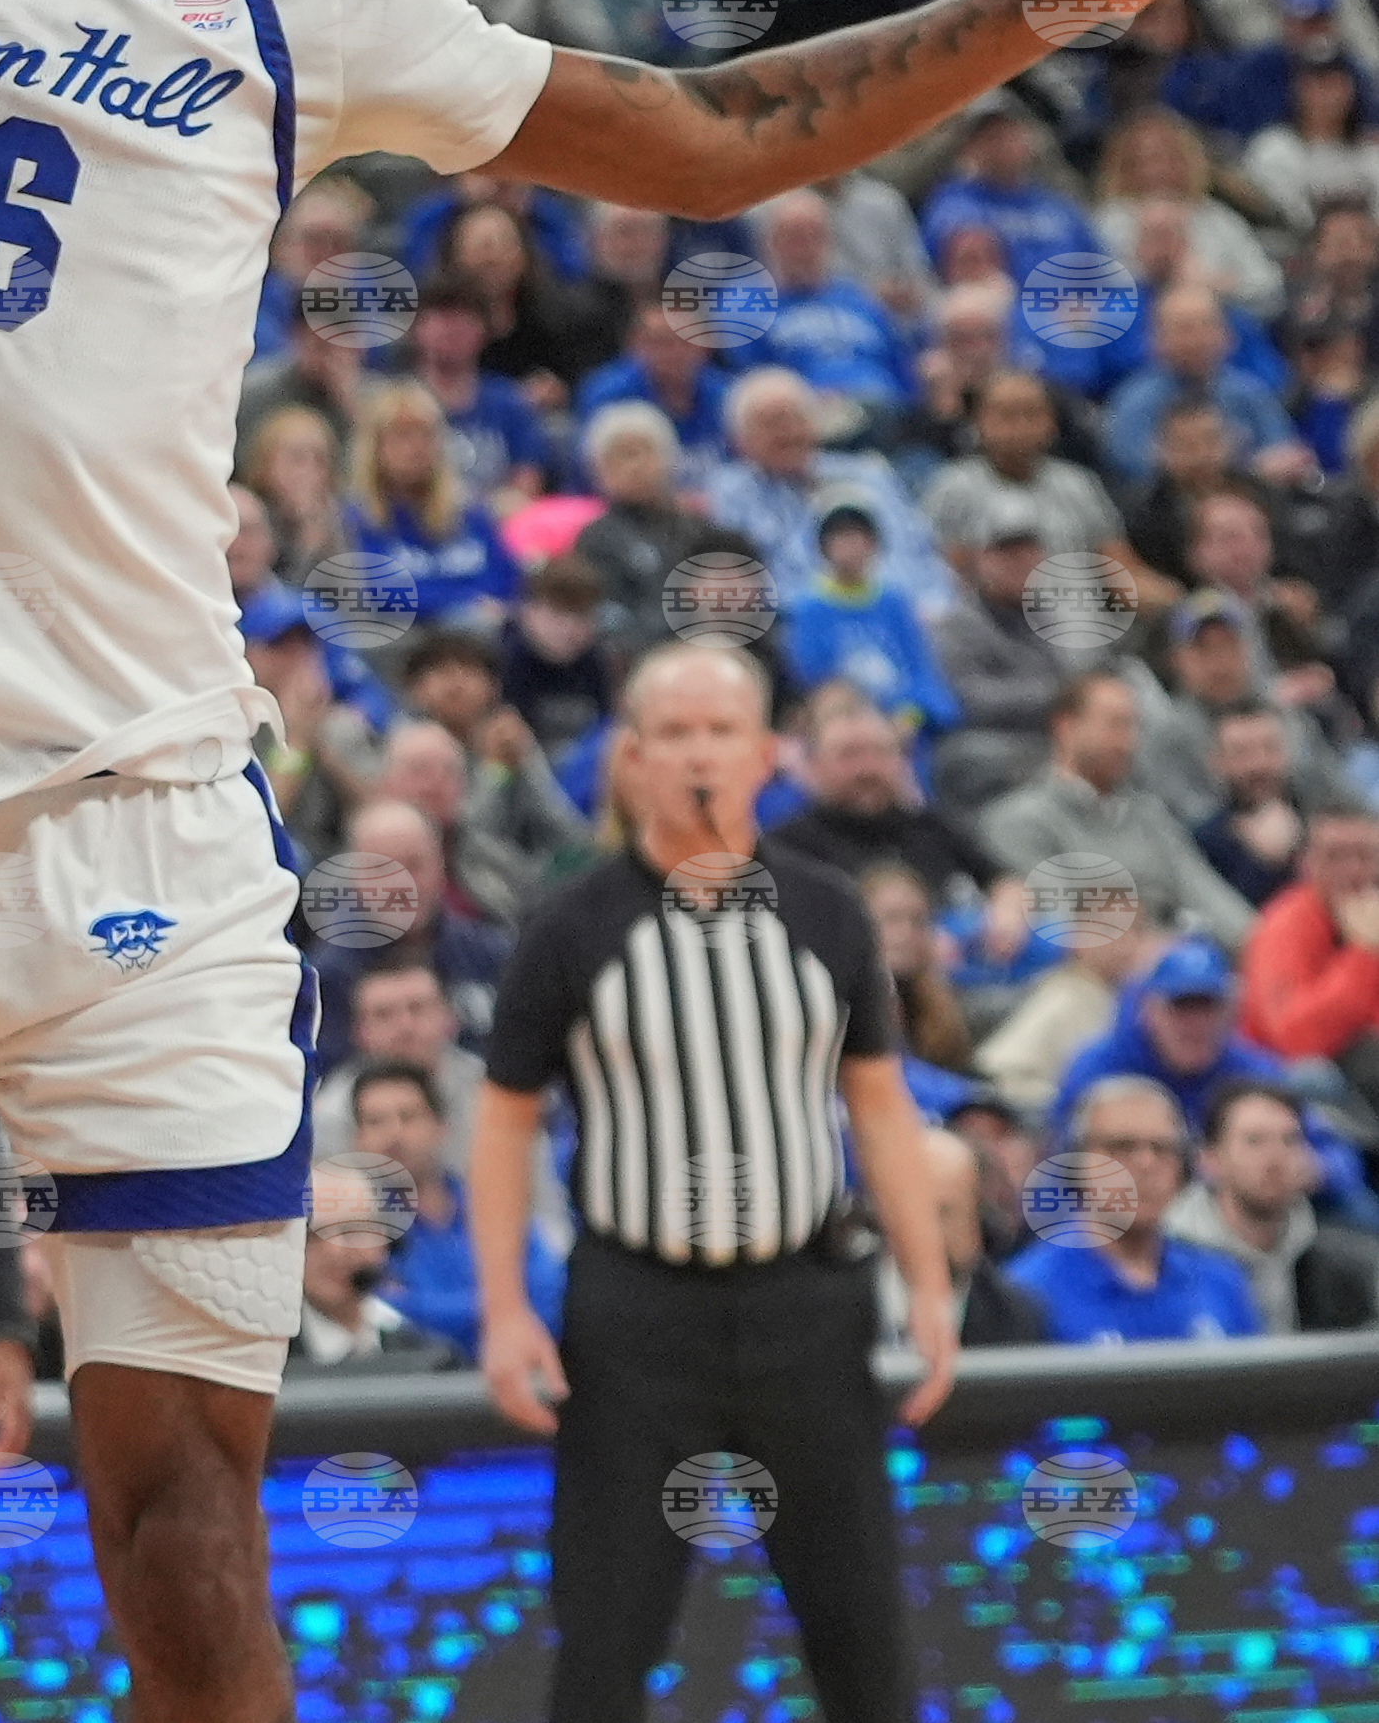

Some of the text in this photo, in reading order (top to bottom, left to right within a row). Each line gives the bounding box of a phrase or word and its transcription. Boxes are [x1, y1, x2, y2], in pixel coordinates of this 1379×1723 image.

[181, 10, 225, 22] BIG
[186, 16, 238, 31] AST
[49, 21, 245, 137] Hall
